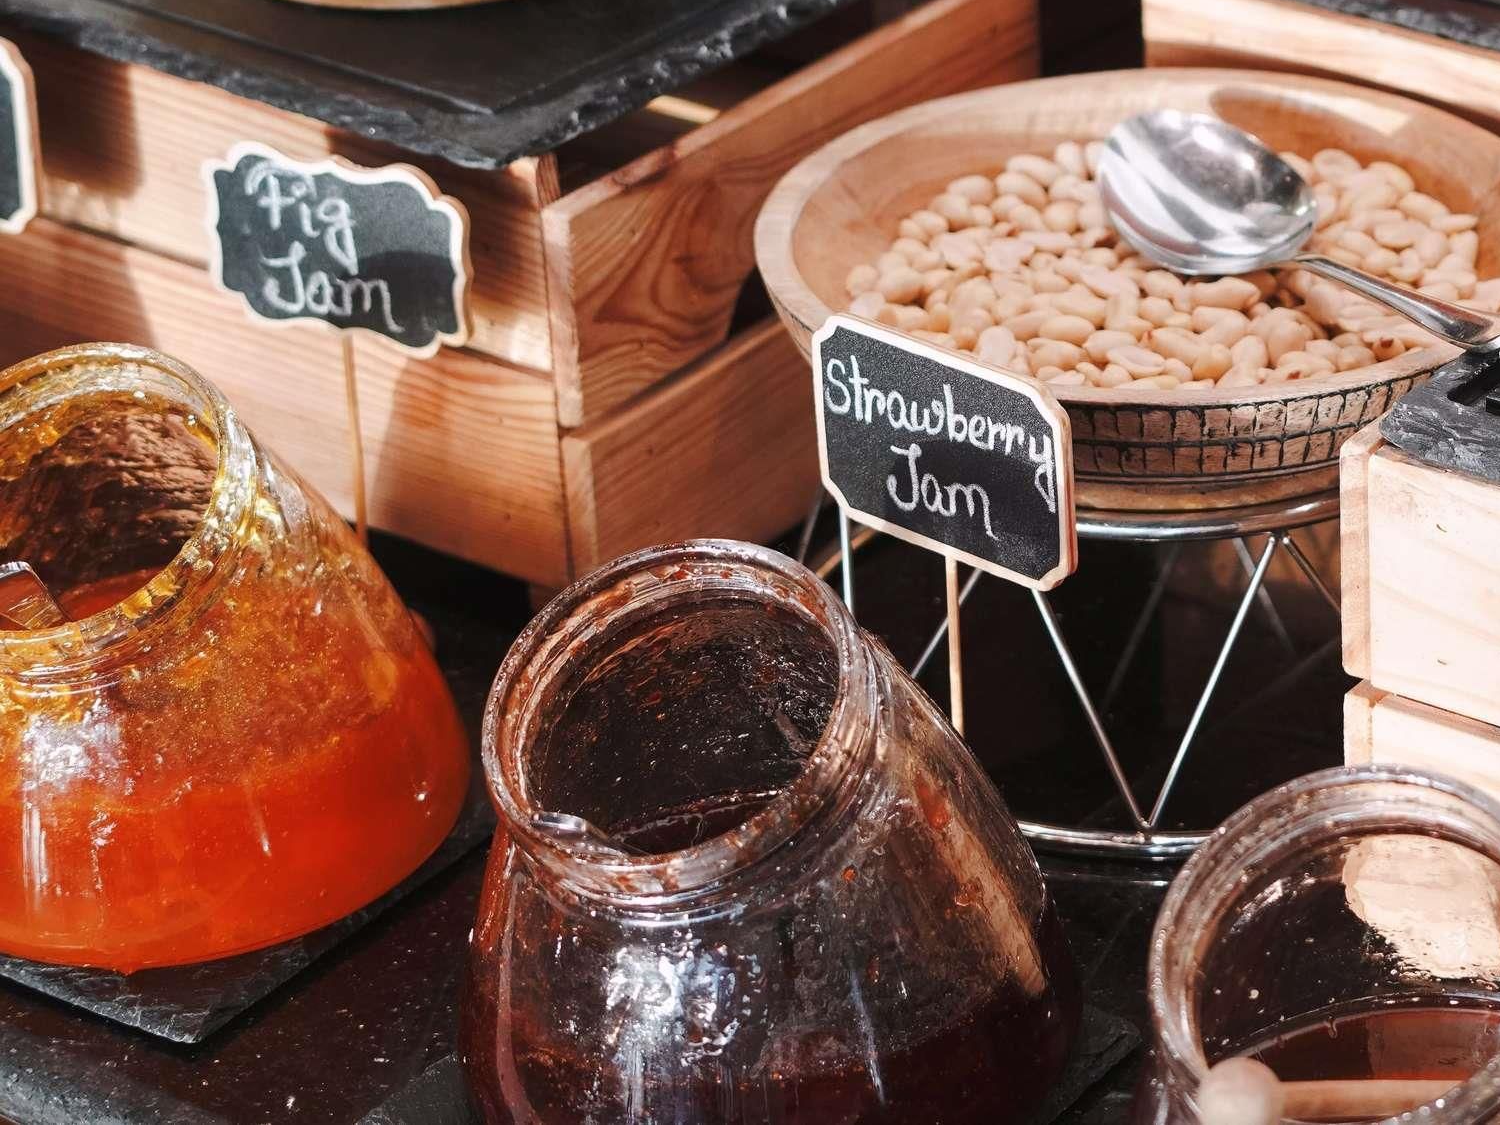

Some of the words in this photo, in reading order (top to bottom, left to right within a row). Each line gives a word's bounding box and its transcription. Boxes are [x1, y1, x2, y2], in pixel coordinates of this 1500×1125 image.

[244, 159, 360, 275] Fig
[262, 240, 405, 333] Jam
[825, 354, 1056, 514] Strawberry
[886, 442, 999, 541] Jam
